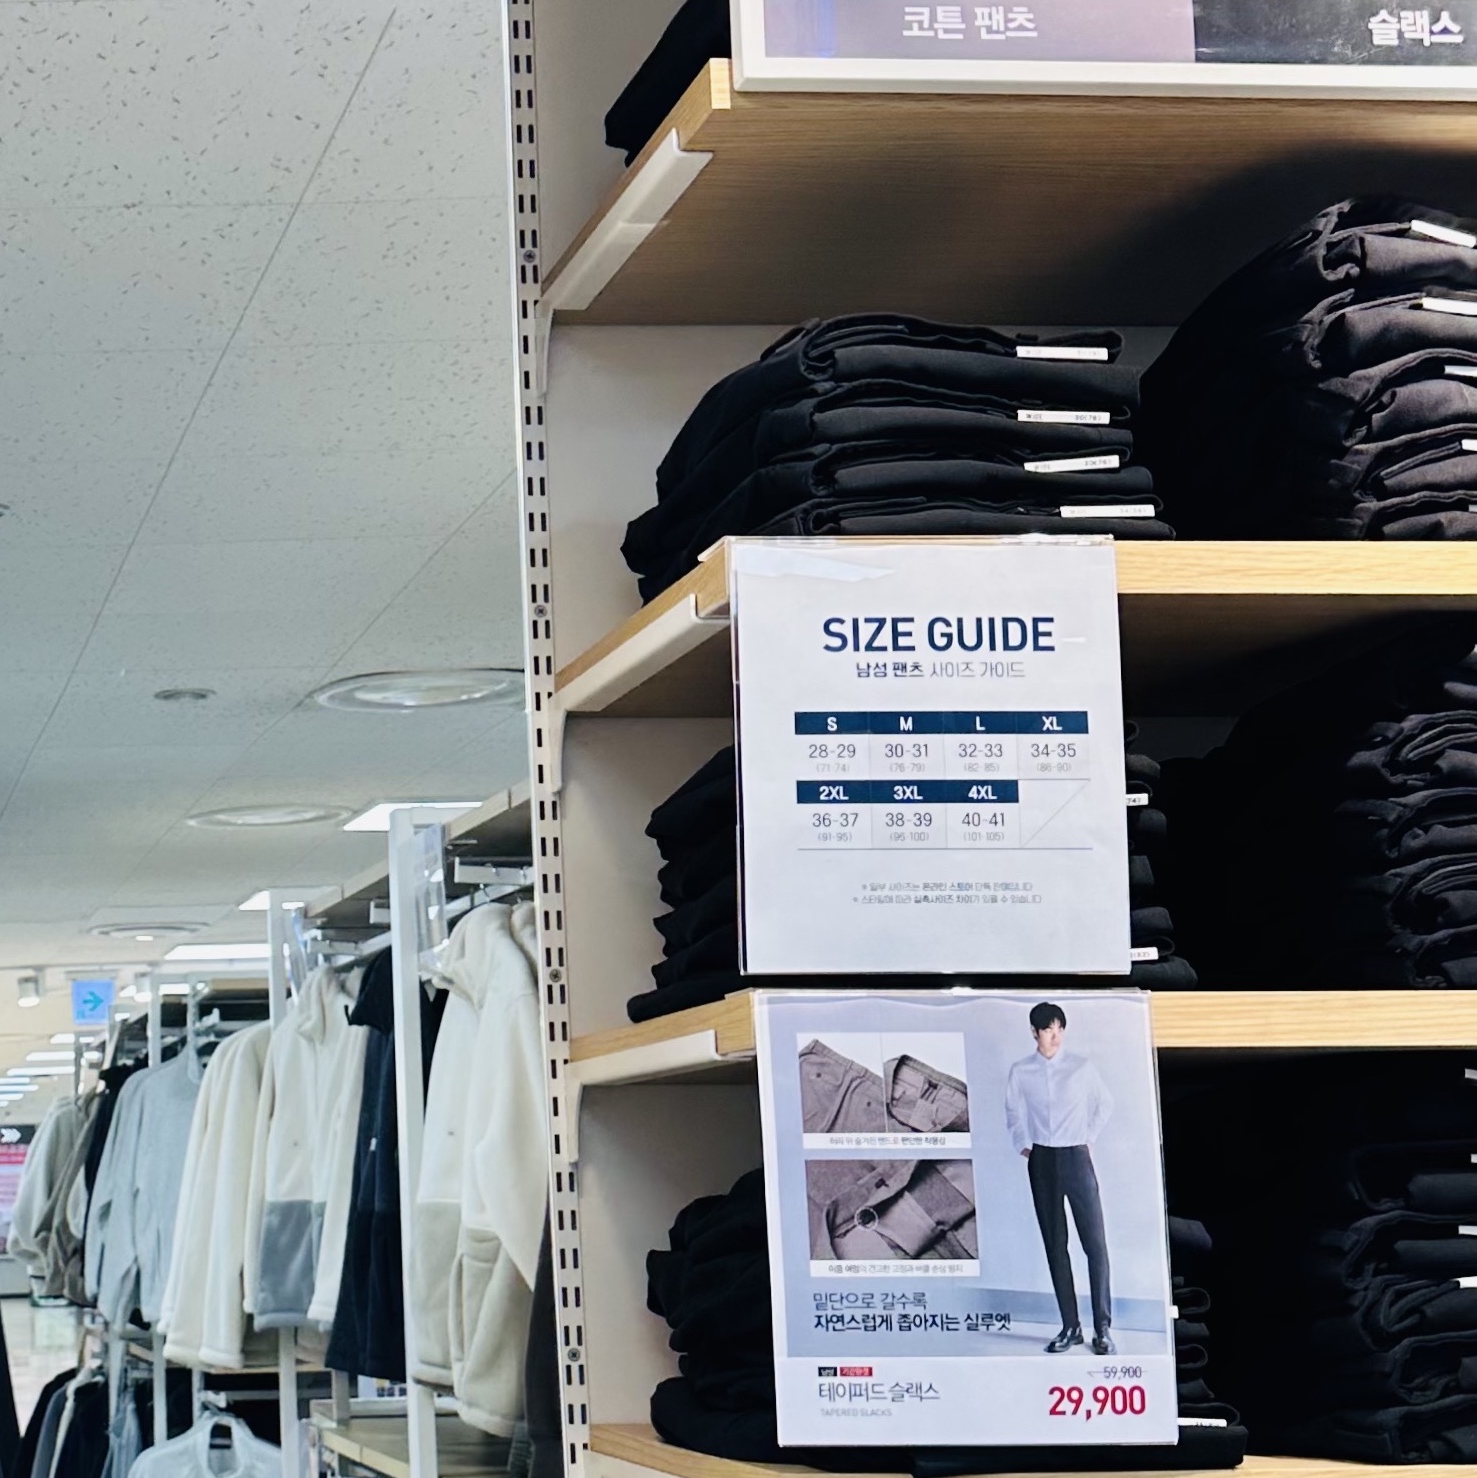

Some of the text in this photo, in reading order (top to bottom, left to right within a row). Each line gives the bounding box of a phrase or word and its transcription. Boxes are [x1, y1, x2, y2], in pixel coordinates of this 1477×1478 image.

[902, 5, 1038, 41] 코튼 팬츠
[1368, 9, 1464, 48] 슬랙스
[822, 616, 1056, 652] SIZE GUIDE
[856, 661, 1026, 678] 남성 팬츠 사이즈 가이드
[827, 717, 838, 732] S
[900, 717, 913, 732] M
[976, 717, 985, 732] L
[1042, 717, 1063, 732] XL
[808, 743, 857, 759] 28-29
[884, 743, 929, 759] 30-31
[958, 743, 1004, 759] 32-33
[1031, 743, 1077, 759] 34-35
[819, 786, 849, 801] 2XL
[893, 786, 924, 801] 3XL
[968, 786, 997, 801] 4XL
[812, 812, 859, 828] 36-37
[885, 812, 933, 828] 38-39
[961, 812, 1006, 828] 40-41
[812, 1292, 928, 1311] 밑단으로 갈수록
[813, 1312, 1012, 1332] 자연스럽게 좁아지는 실루엣
[1103, 1366, 1143, 1380] 59,900
[1048, 1386, 1147, 1421] 29,900
